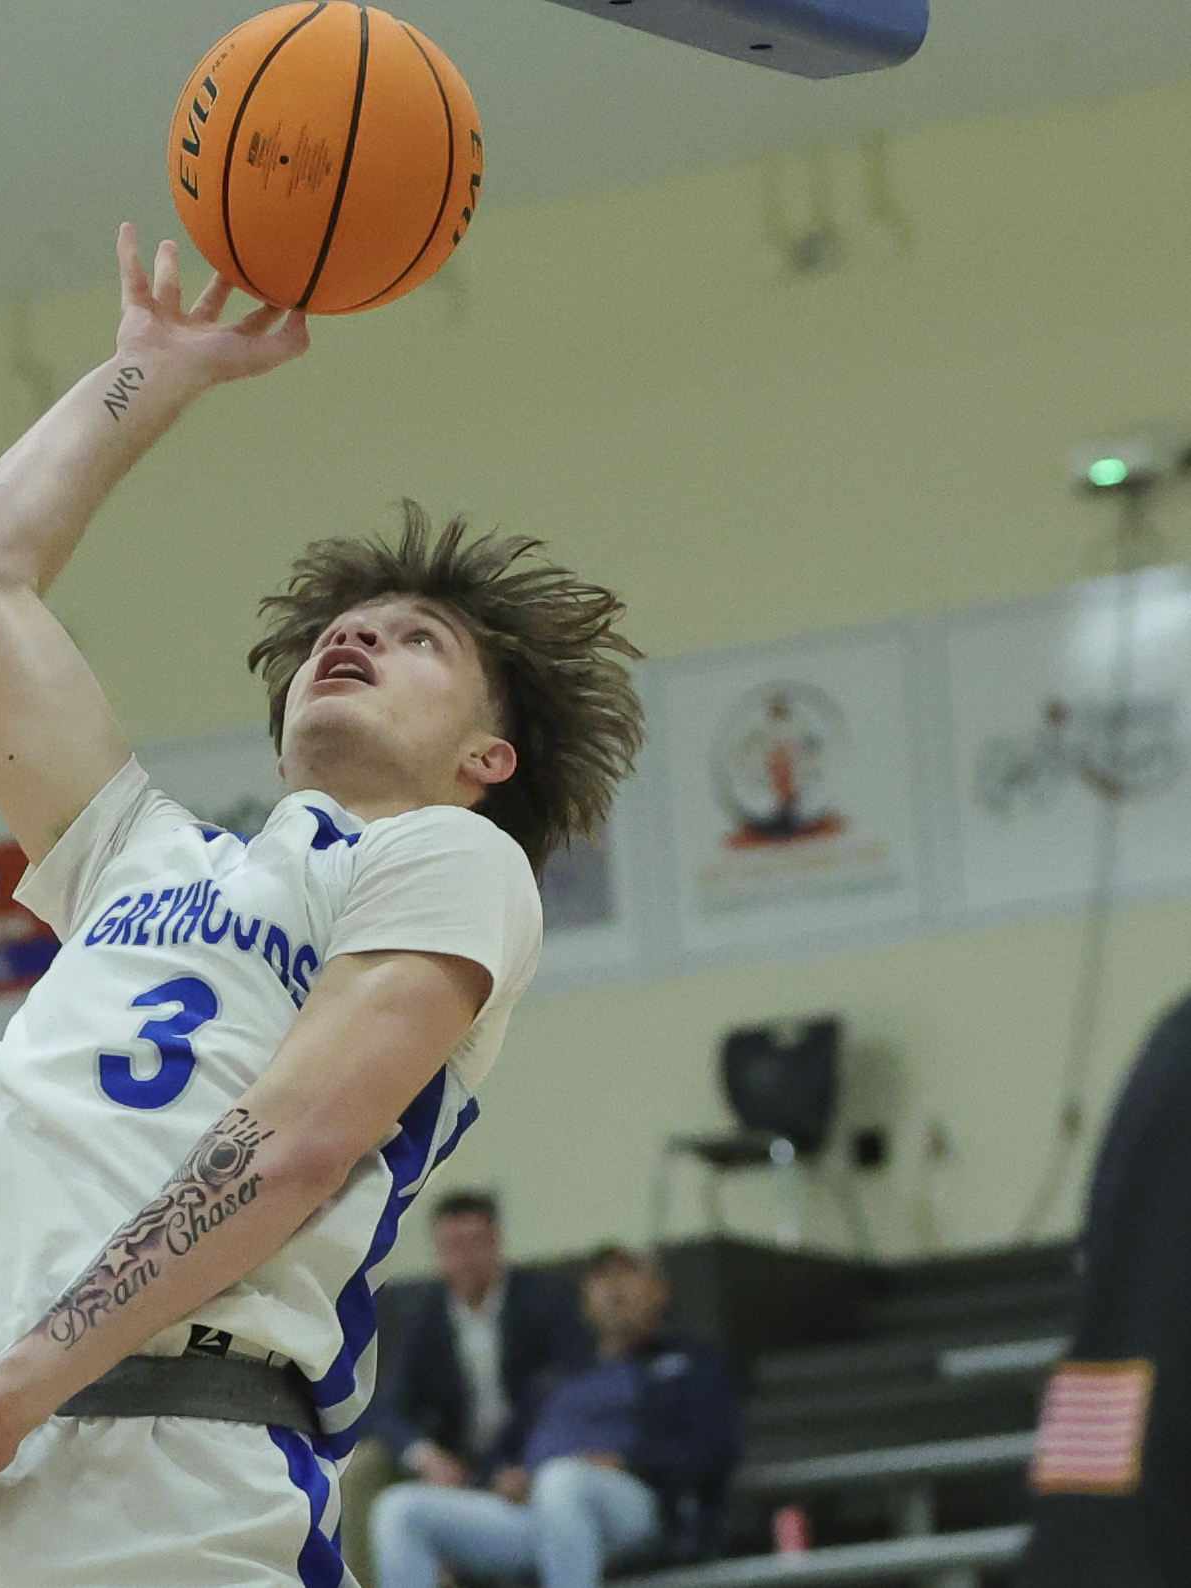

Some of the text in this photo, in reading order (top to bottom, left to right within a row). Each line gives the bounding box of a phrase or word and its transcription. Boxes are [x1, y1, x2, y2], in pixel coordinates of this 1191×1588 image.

[180, 75, 217, 200] EVO
[84, 879, 319, 1012] GREYHOUDS
[99, 977, 218, 1110] 3
[166, 1173, 262, 1255] Chaser
